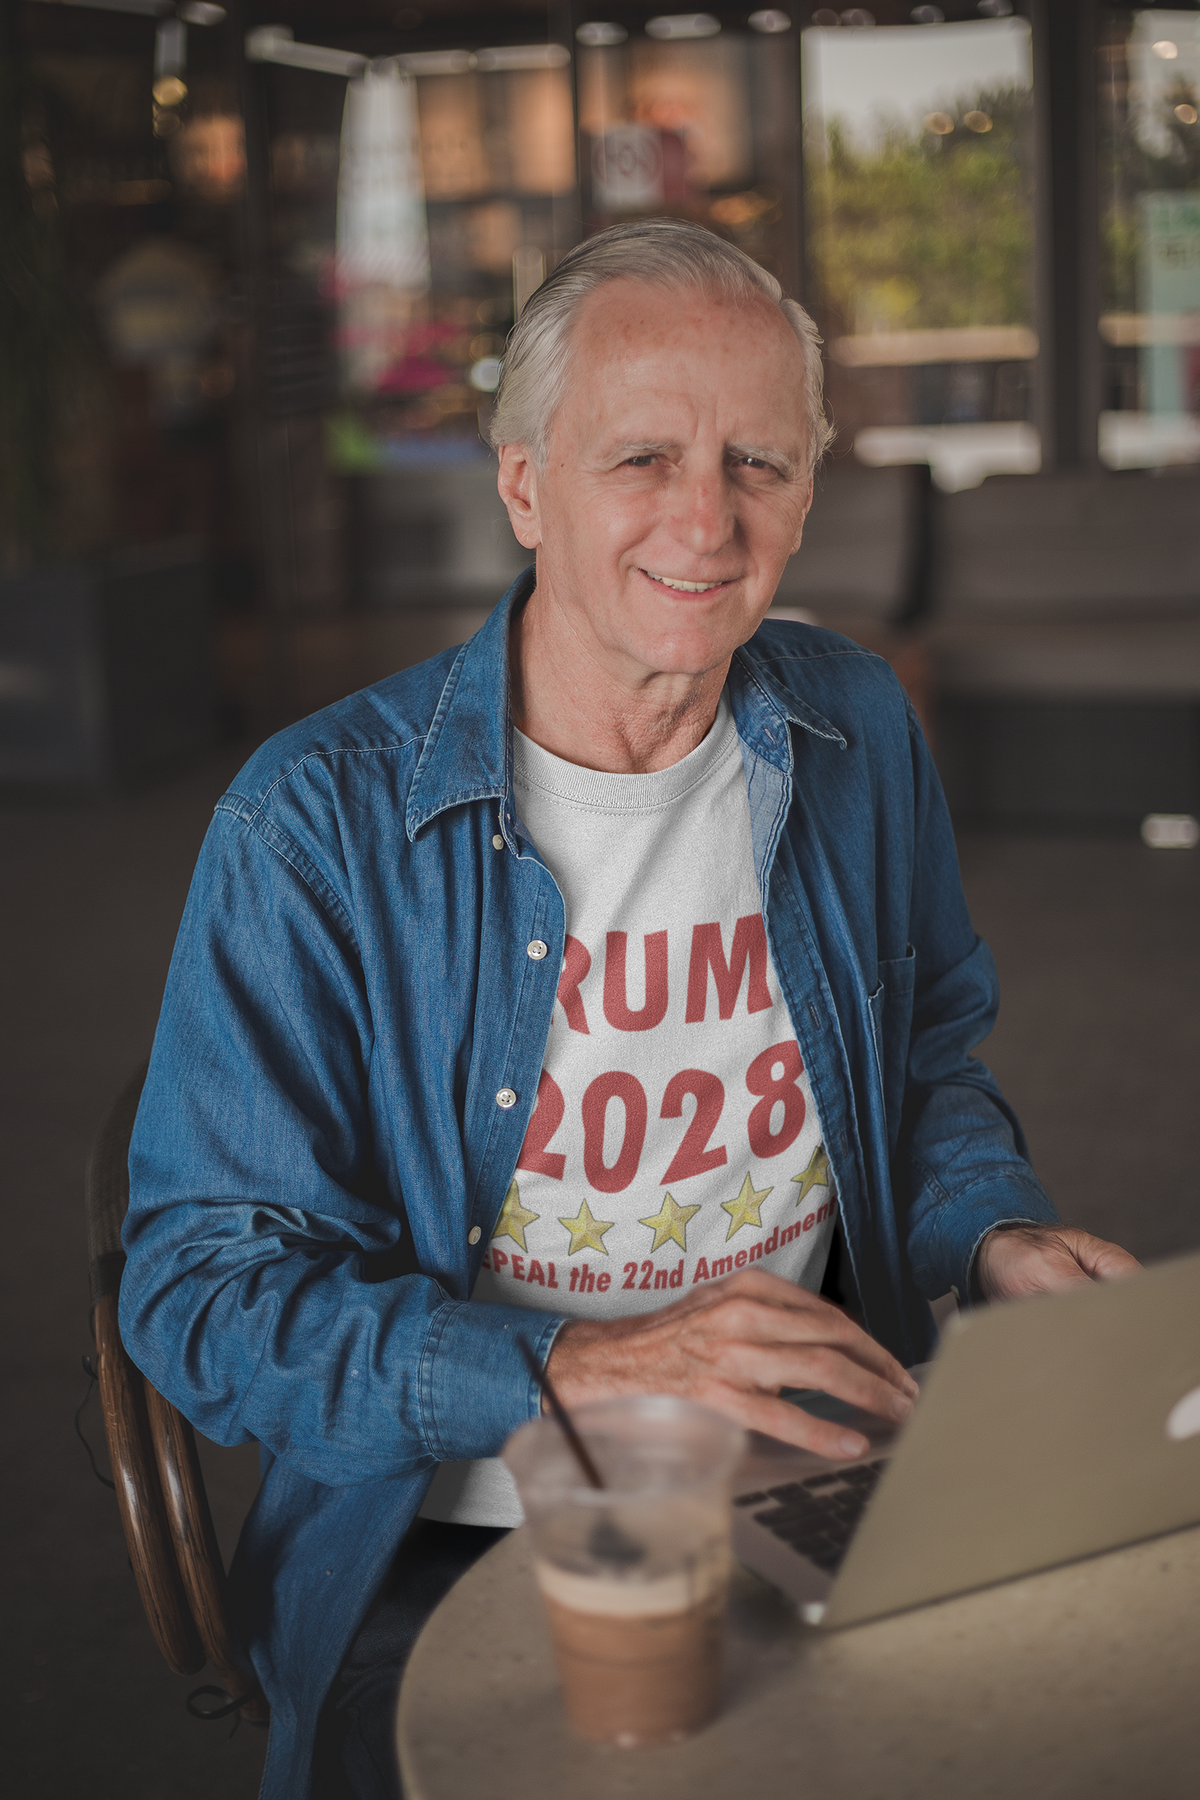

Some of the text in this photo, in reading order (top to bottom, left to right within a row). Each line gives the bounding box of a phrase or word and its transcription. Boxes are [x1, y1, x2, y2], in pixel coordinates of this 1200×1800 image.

[516, 1039, 806, 1193] 2028
[569, 1263, 611, 1292] the
[621, 1259, 684, 1290] 22nd
[692, 1195, 837, 1284] Amendment
